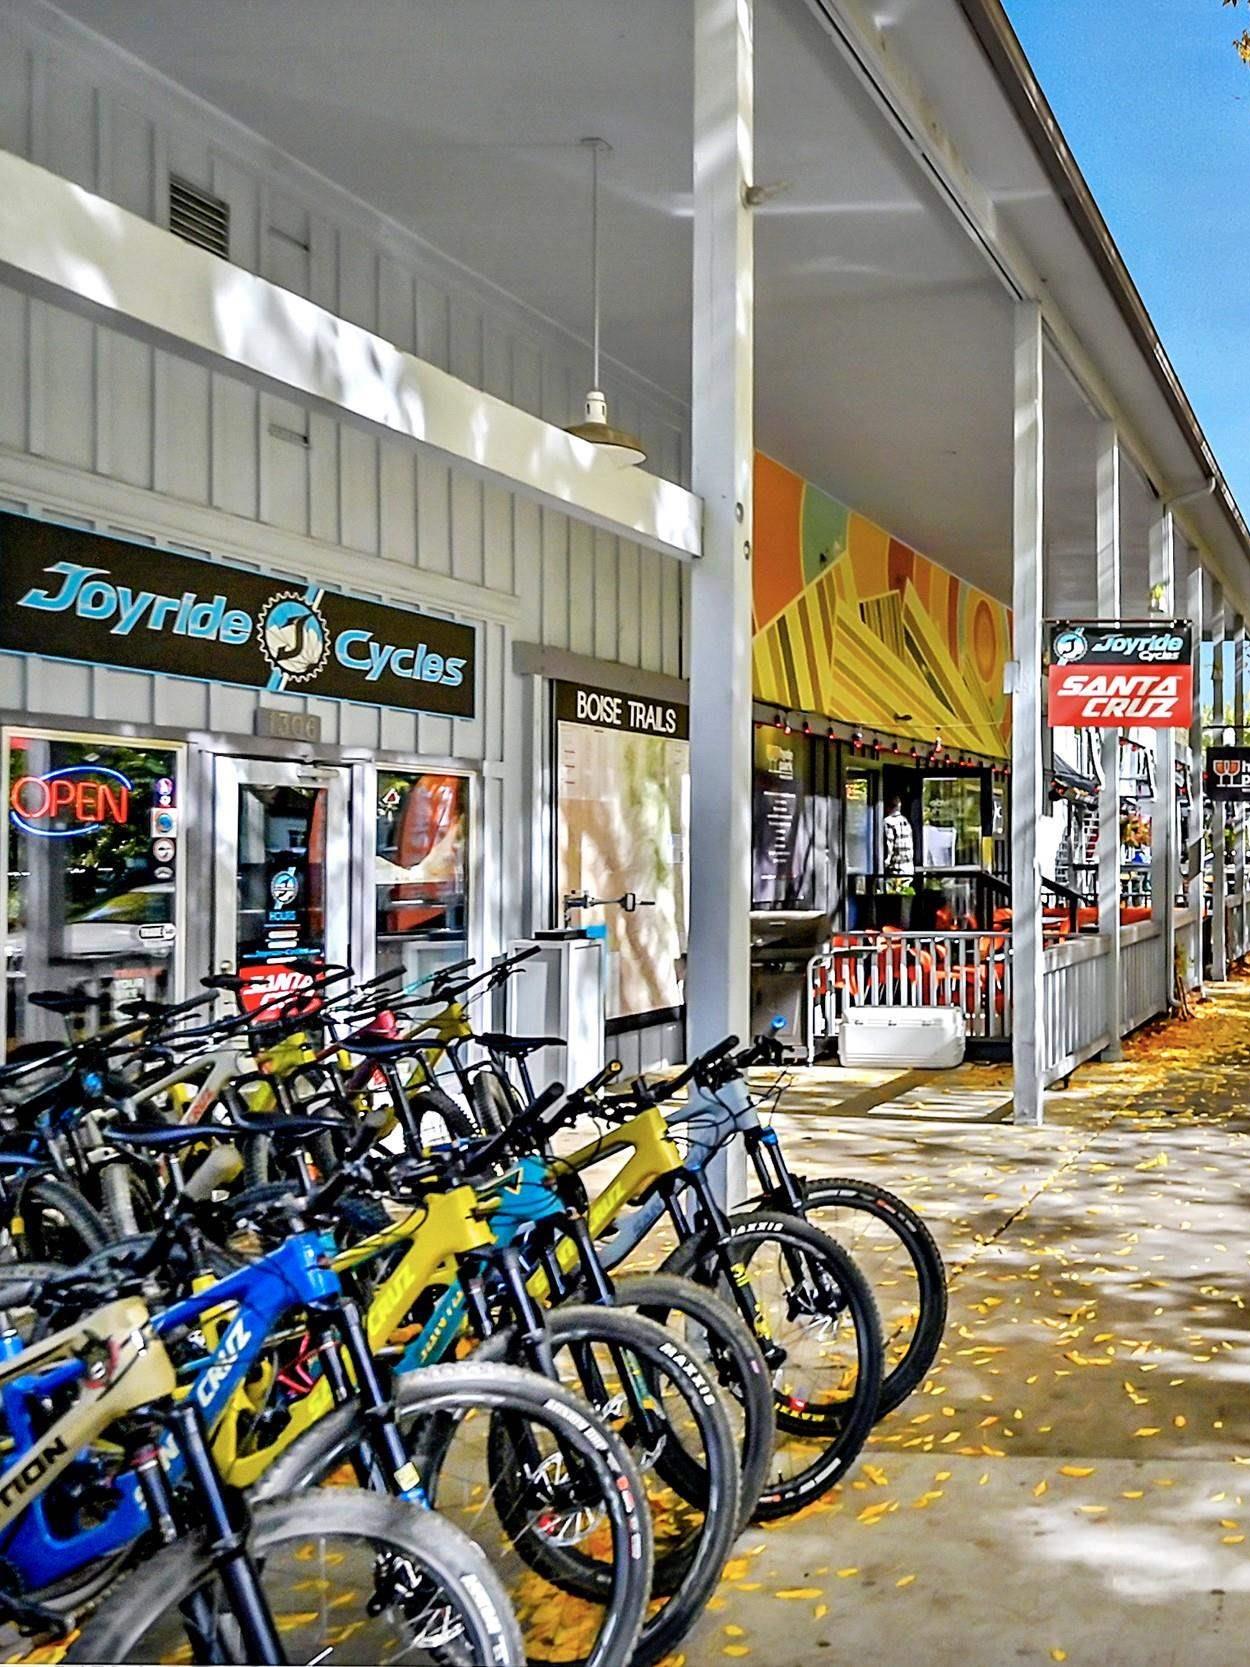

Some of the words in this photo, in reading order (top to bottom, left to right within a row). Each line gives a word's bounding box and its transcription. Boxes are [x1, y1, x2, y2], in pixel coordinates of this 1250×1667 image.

[16, 561, 253, 645] Joyride
[335, 629, 467, 686] Cycles
[1091, 633, 1183, 655] Joyride
[1138, 651, 1180, 661] Cycles
[1056, 675, 1178, 696] SANTA
[269, 711, 316, 739] 1306
[576, 690, 622, 725] BOISE
[628, 700, 677, 733] TRAILS
[1081, 697, 1179, 718] CRUZ
[11, 776, 129, 824] OPEN
[196, 1317, 252, 1408] CRUZ
[659, 1342, 717, 1406] MAXXIS
